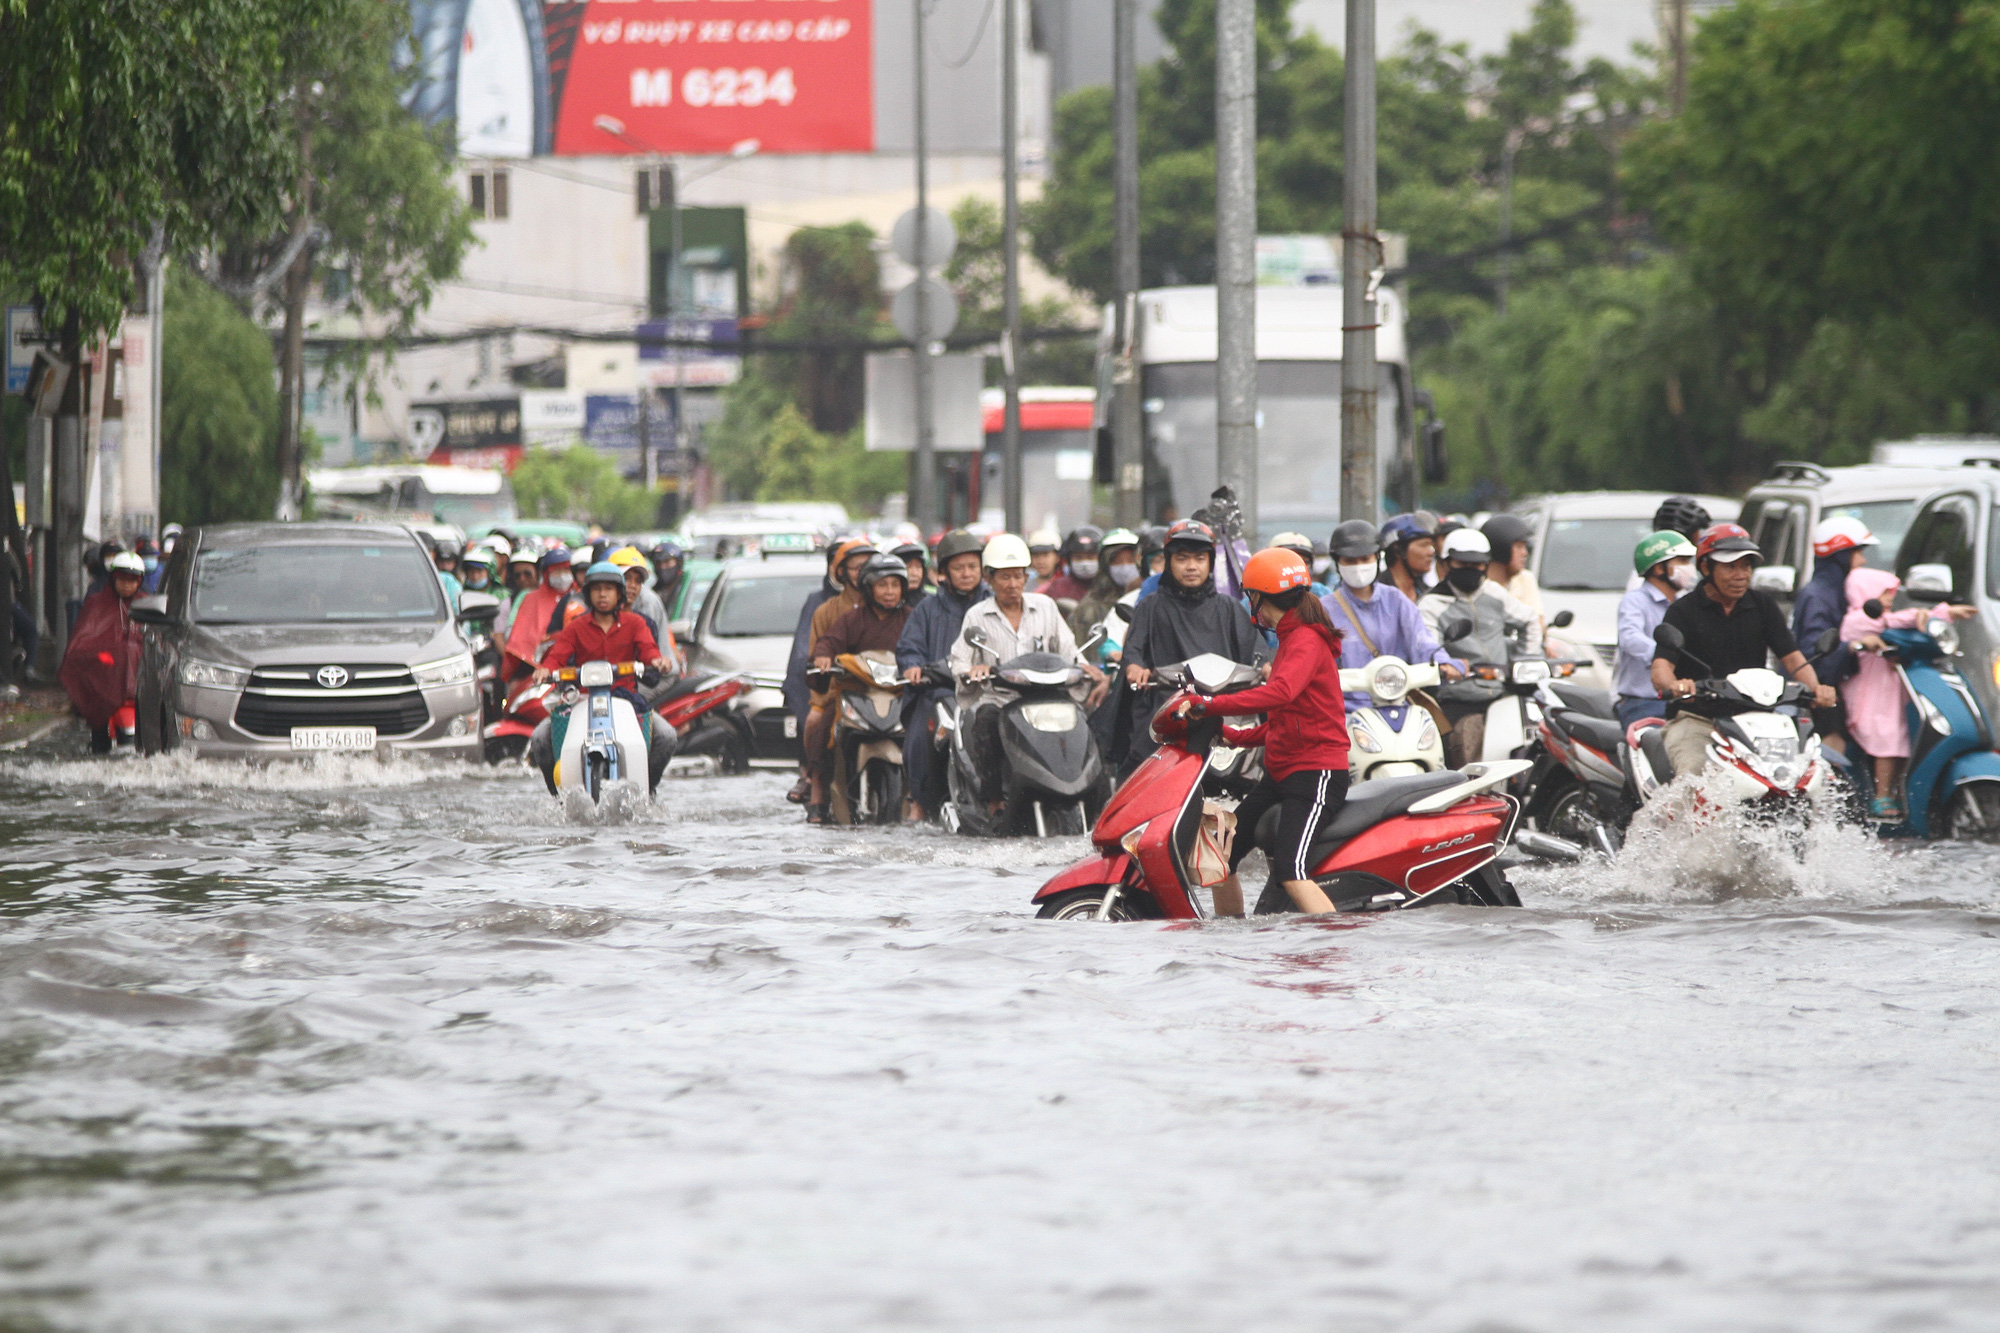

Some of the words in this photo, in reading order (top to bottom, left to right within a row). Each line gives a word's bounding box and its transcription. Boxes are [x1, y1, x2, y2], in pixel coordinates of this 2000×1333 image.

[697, 19, 735, 43] XE
[736, 19, 793, 42] CAO
[630, 67, 673, 107] M
[682, 67, 797, 107] 6234
[294, 731, 320, 748] 51G
[1422, 833, 1475, 853] LEAD
